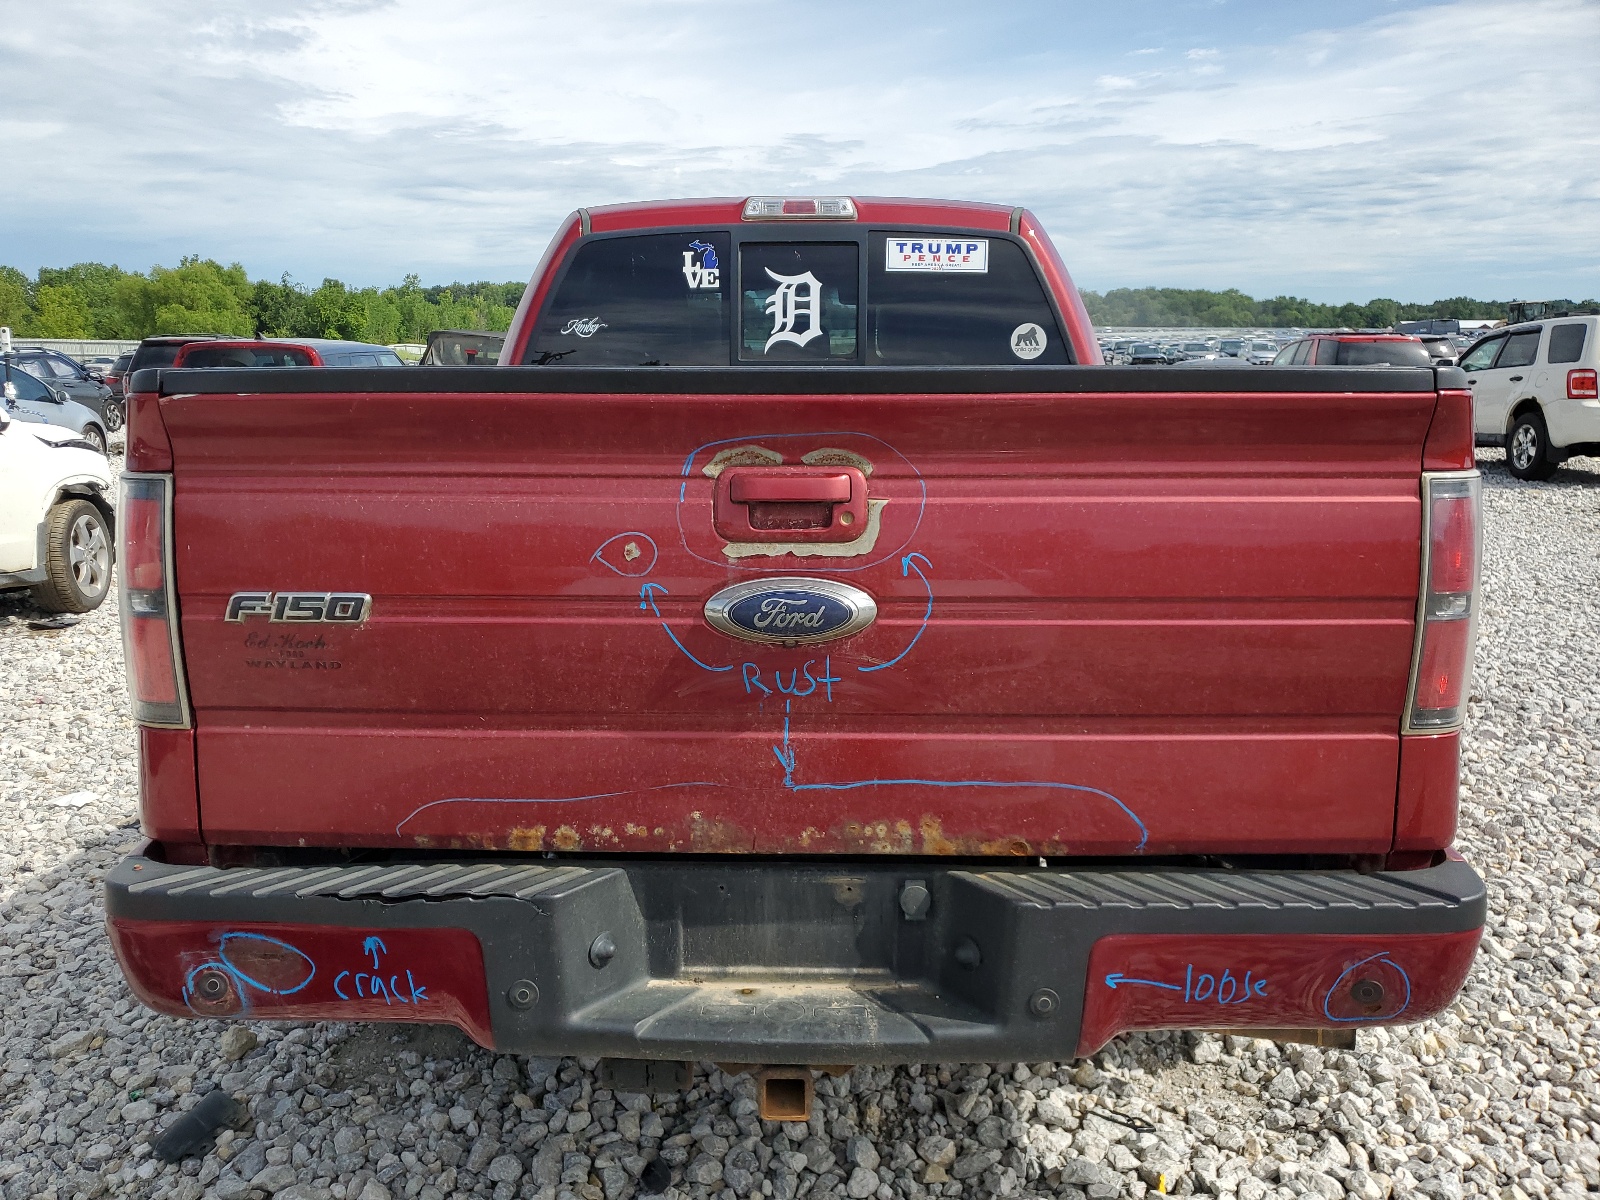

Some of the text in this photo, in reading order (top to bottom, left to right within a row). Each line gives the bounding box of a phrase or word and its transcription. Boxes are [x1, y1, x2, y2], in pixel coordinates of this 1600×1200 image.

[896, 243, 979, 255] TRUMP
[903, 255, 971, 263] PENCE
[764, 266, 824, 355] D
[224, 592, 373, 624] F-150
[753, 598, 826, 628] Ford
[245, 659, 342, 670] WAYLAND
[334, 969, 429, 1005] crack
